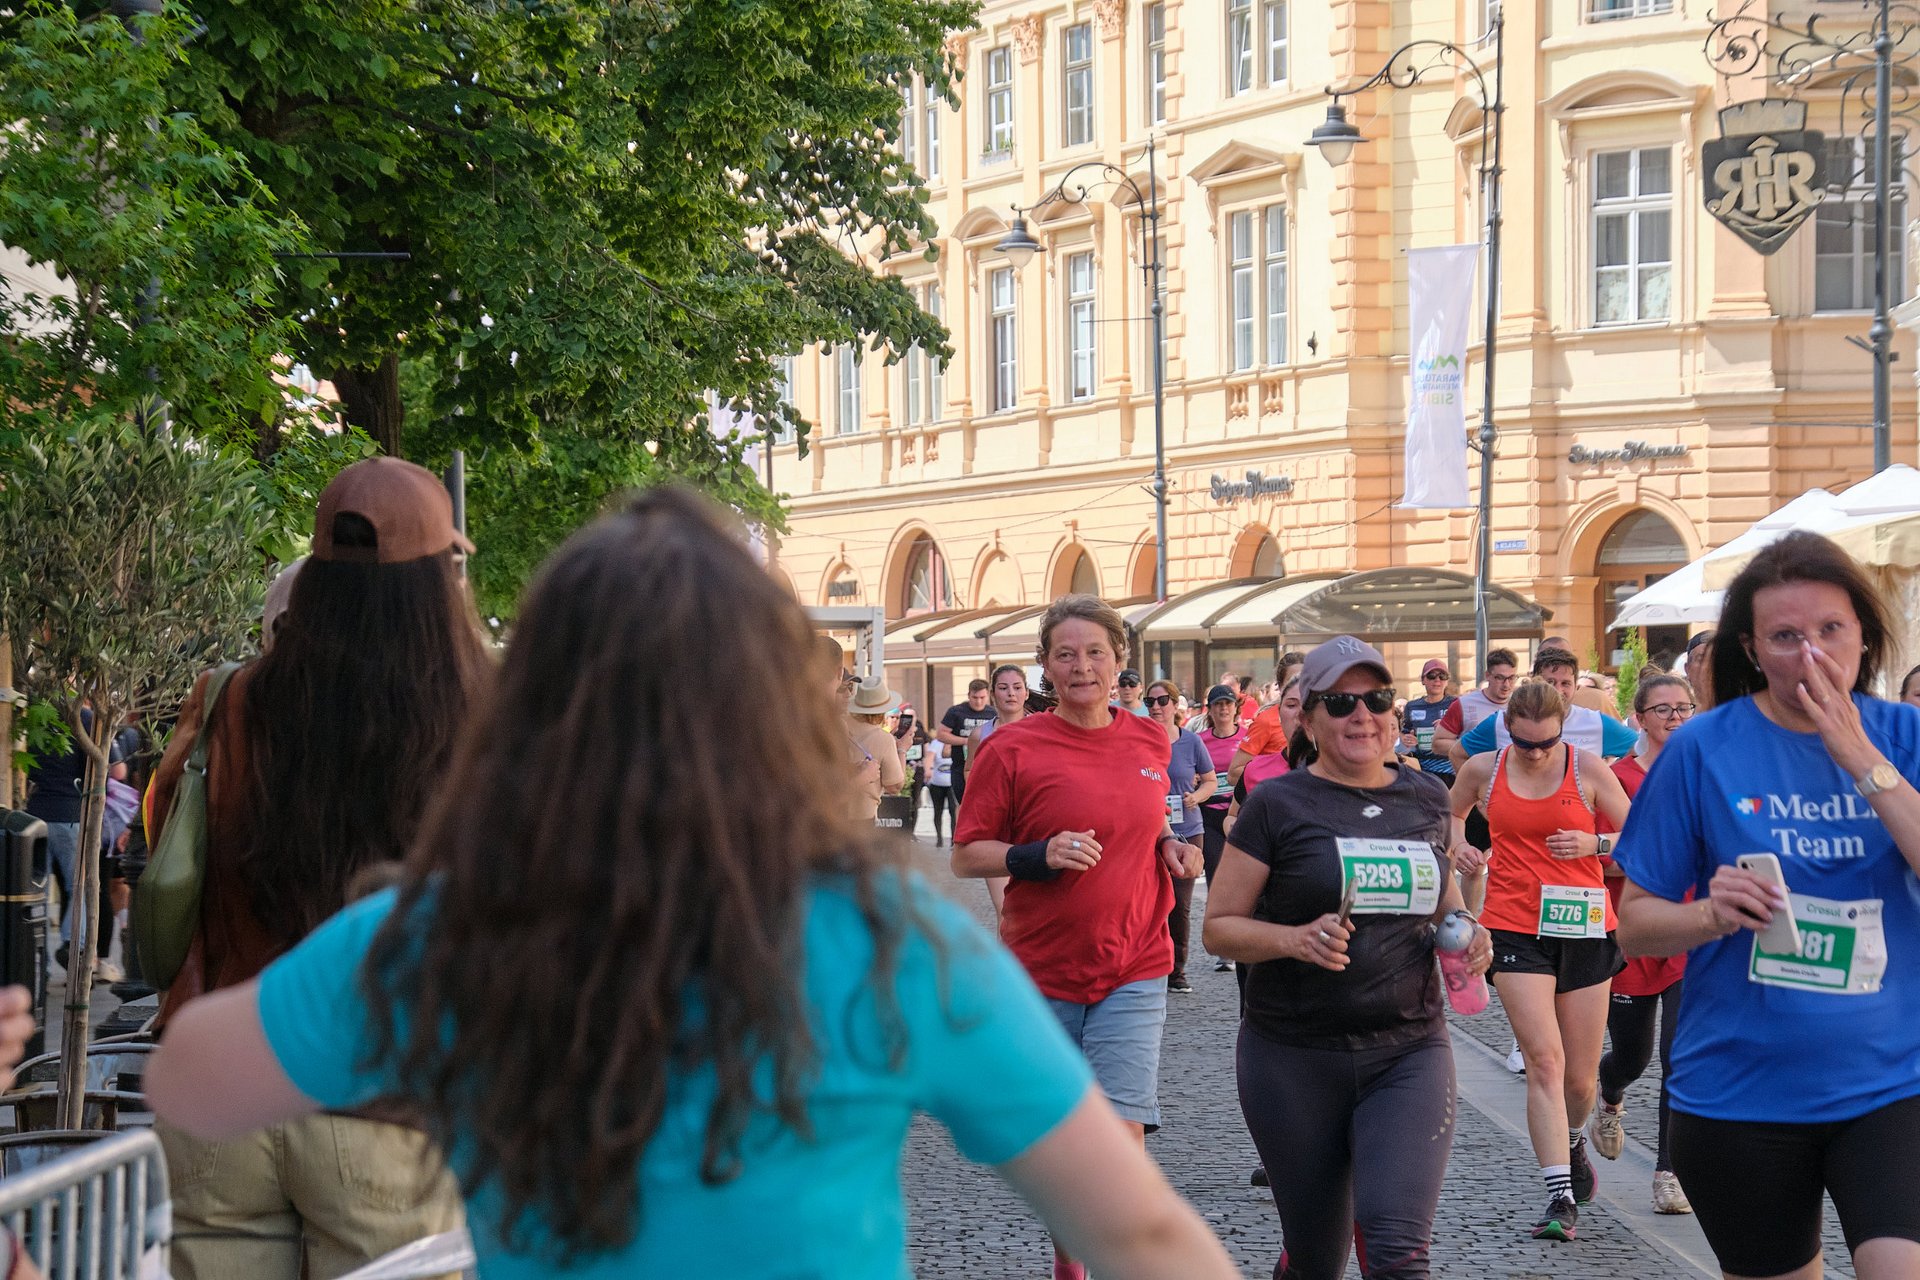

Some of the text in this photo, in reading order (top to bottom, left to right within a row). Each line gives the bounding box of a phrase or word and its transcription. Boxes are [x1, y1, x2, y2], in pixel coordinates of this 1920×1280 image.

[875, 818, 903, 827] ATURO
[1771, 828, 1866, 859] Team
[1353, 863, 1403, 888] 5293
[1549, 903, 1583, 922] 5776
